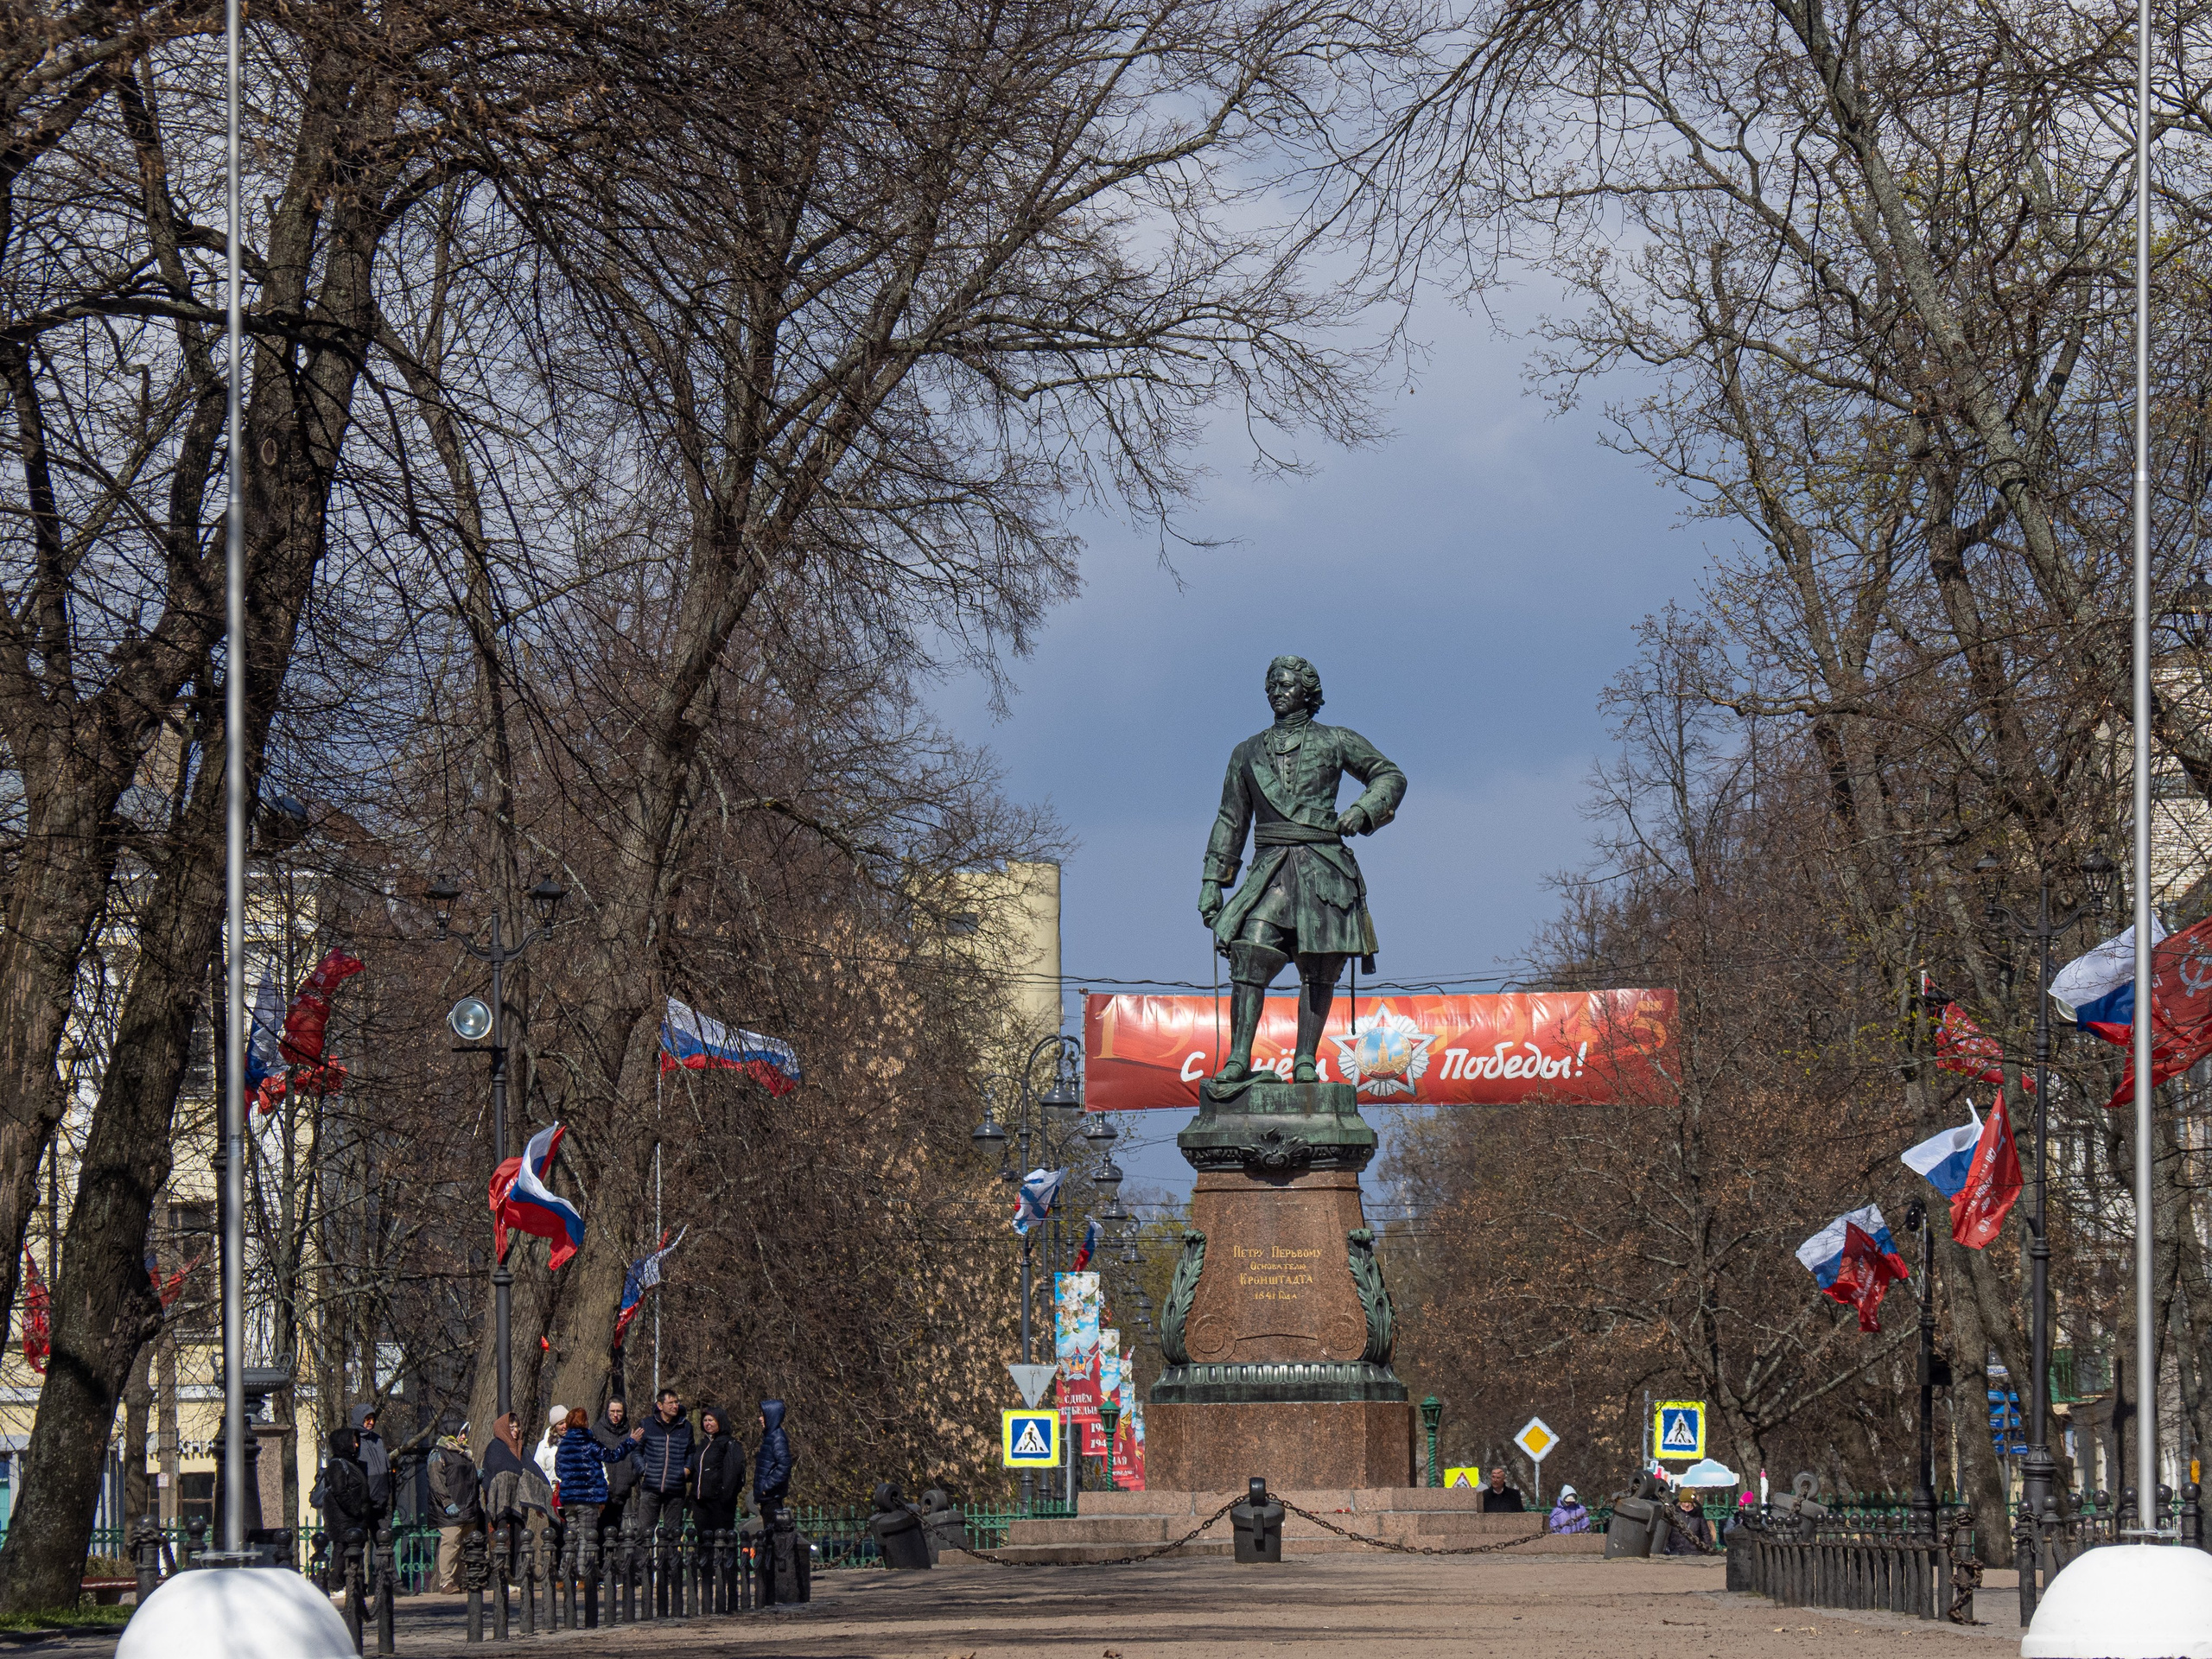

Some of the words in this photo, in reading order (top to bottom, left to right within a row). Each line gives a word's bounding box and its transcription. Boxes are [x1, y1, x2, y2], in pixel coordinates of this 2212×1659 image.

[1180, 1052, 1206, 1082] С
[1440, 1041, 1587, 1080] Победы!
[1254, 1291, 1276, 1300] 1841
[1090, 1439, 1107, 1448] 194
